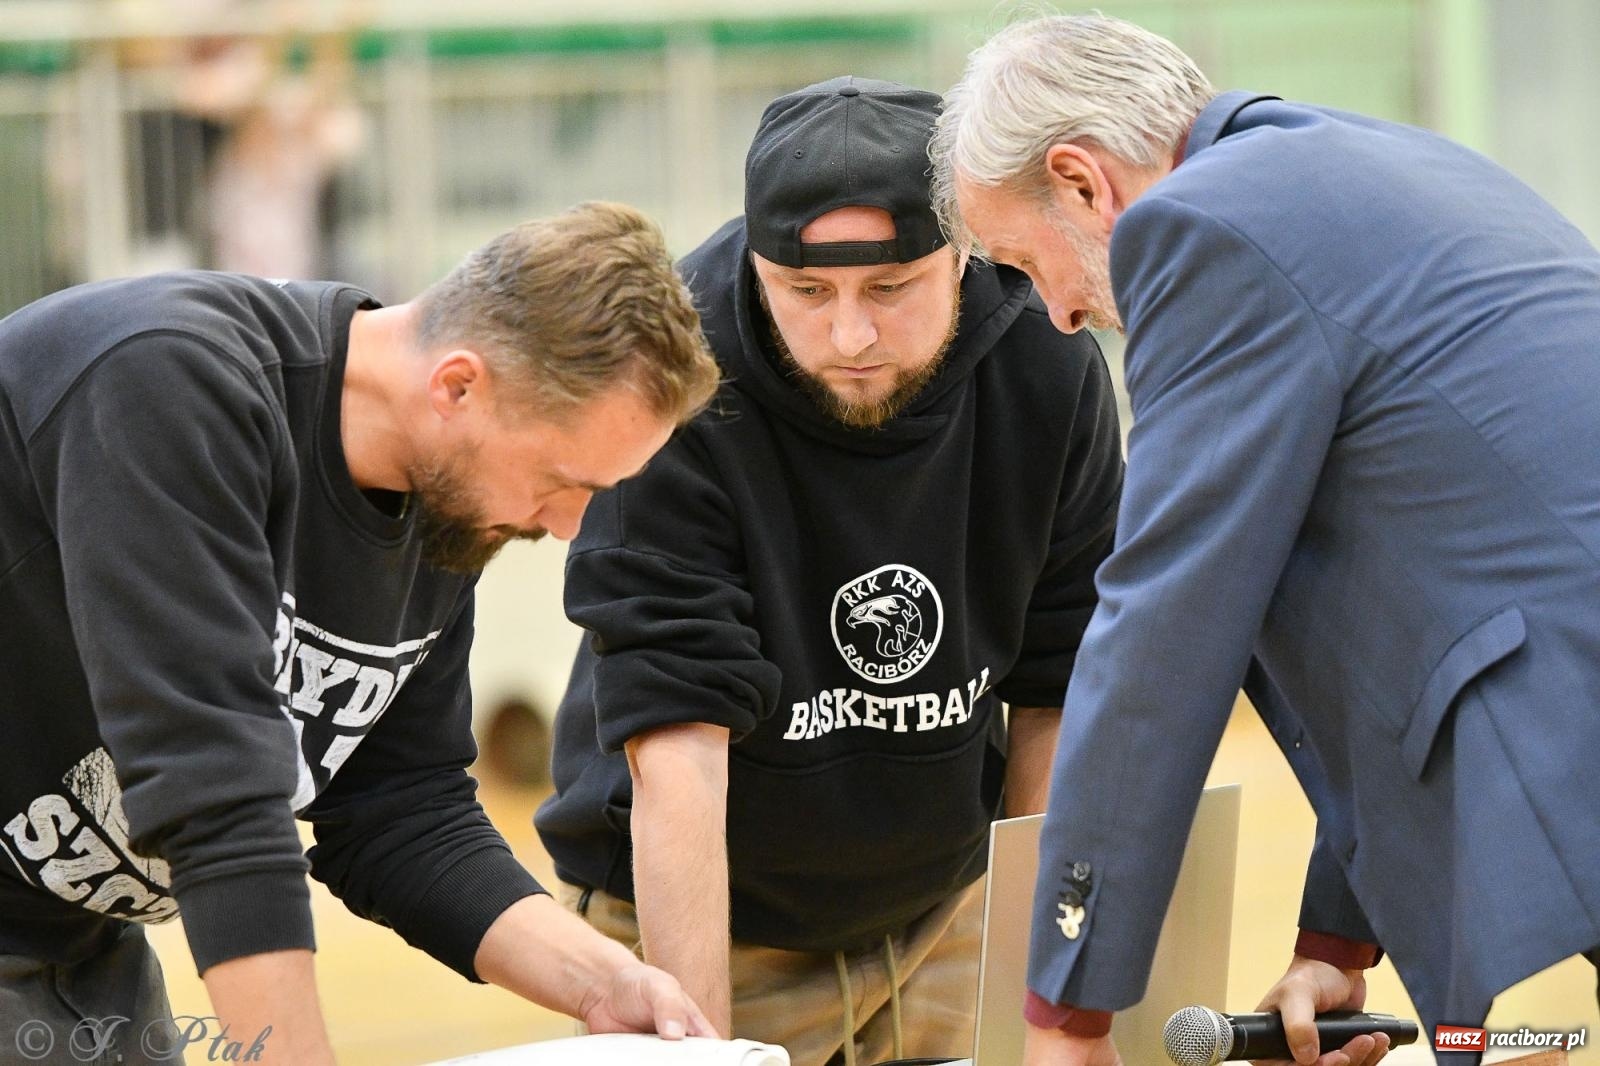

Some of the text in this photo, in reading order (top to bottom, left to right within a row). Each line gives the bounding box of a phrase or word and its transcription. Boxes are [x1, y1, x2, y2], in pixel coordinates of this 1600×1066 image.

[842, 570, 926, 607] RKK AZS
[843, 638, 932, 678] RACIBÓRZ
